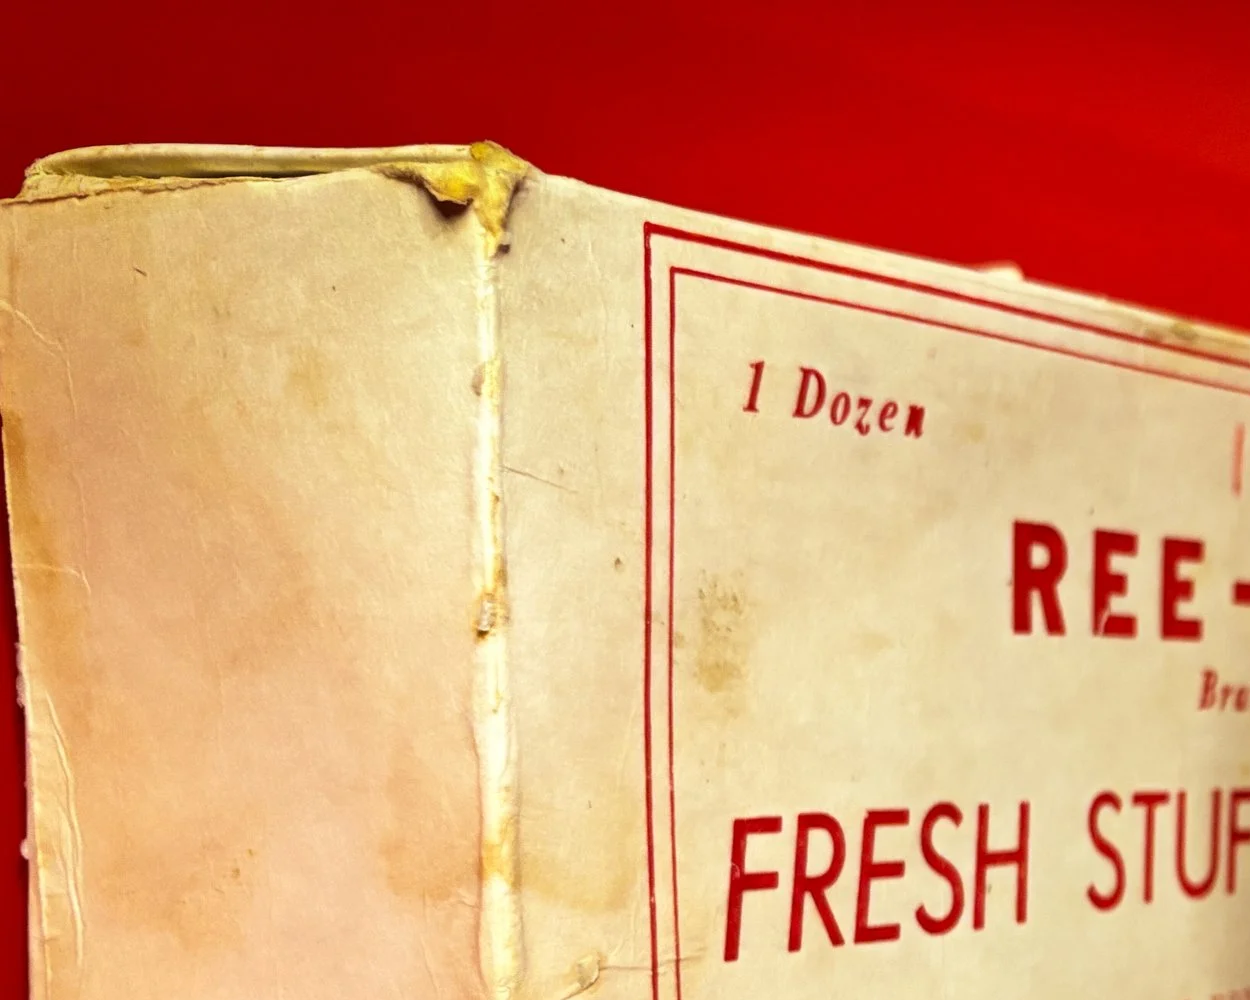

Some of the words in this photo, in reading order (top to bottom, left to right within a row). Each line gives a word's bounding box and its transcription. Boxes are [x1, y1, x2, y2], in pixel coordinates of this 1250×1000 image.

[743, 360, 765, 414] 1
[792, 366, 926, 438] Dozen
[723, 800, 1031, 963] FRESH
